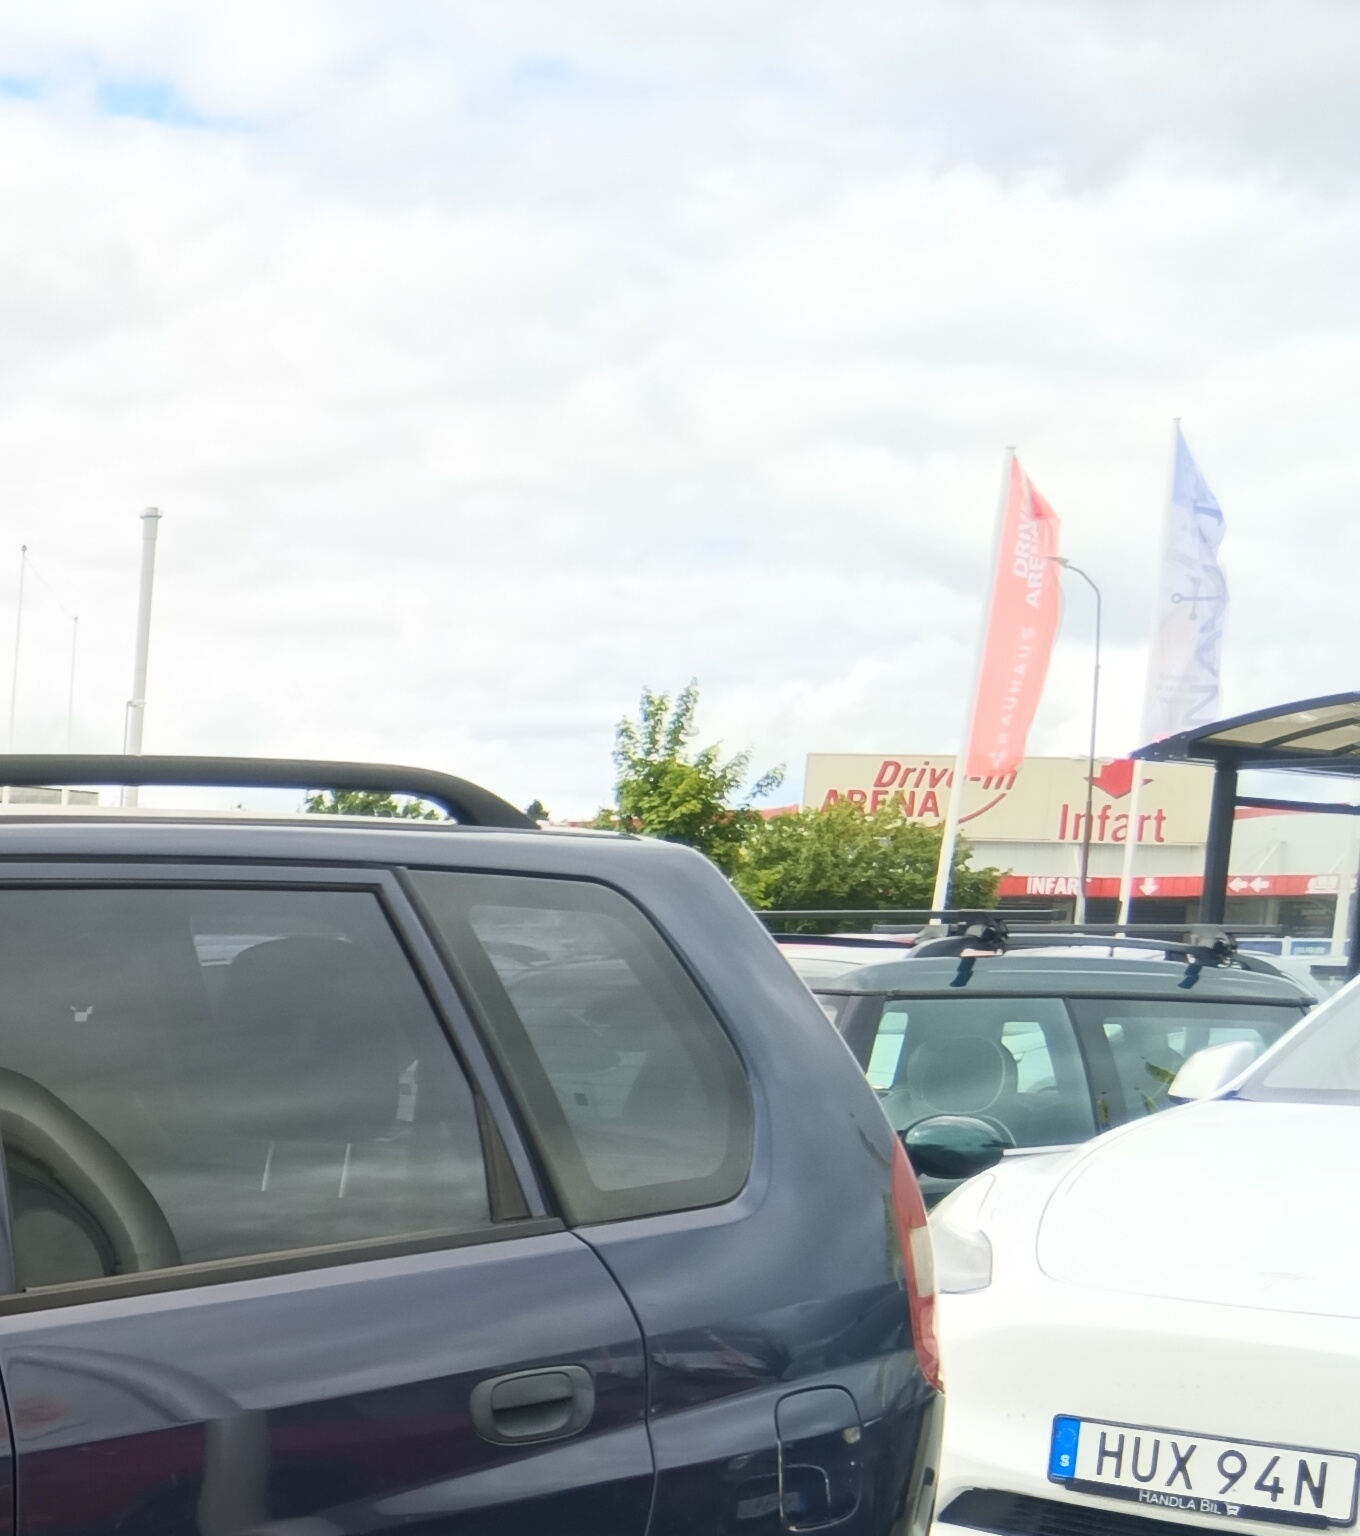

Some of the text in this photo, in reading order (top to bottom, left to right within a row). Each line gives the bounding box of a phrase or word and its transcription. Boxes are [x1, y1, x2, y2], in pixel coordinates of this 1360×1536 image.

[1059, 804, 1166, 842] Infart
[1026, 877, 1092, 895] INFAR
[1059, 1454, 1070, 1467] S
[1096, 1431, 1327, 1508] HUX 94N
[1139, 1490, 1196, 1511] HANDLA
